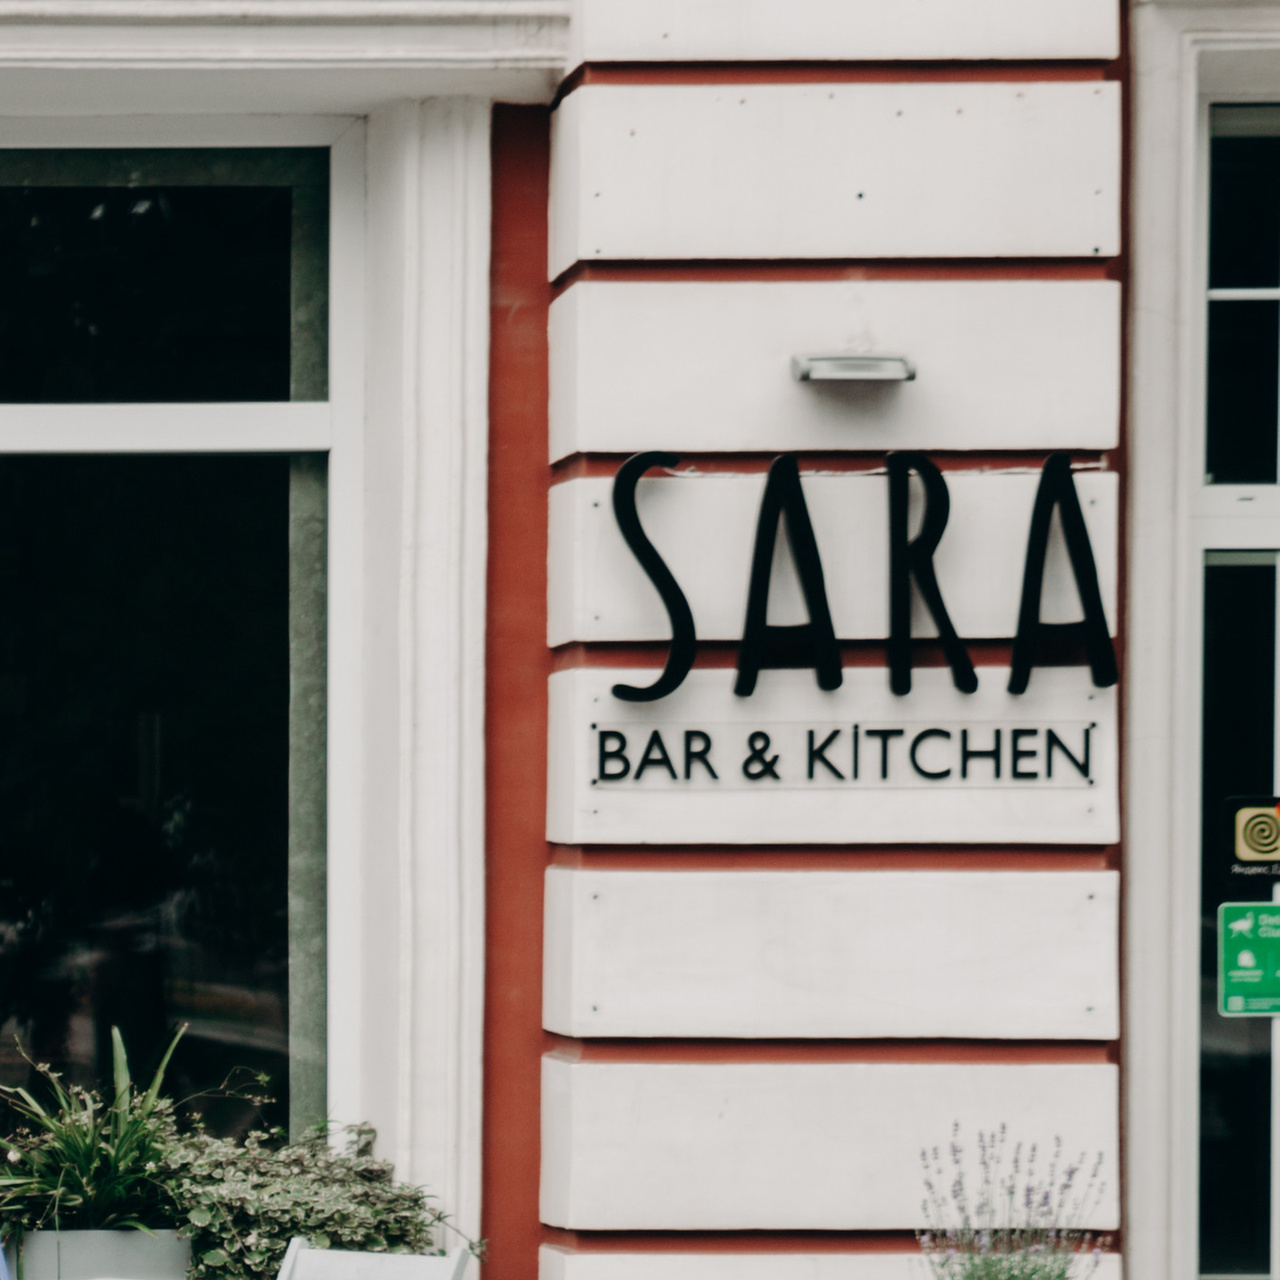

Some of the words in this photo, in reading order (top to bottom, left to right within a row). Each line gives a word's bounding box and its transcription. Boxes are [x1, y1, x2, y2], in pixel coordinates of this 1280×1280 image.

[611, 450, 1118, 702] SARA
[597, 729, 718, 781] BAR
[741, 730, 781, 781] &
